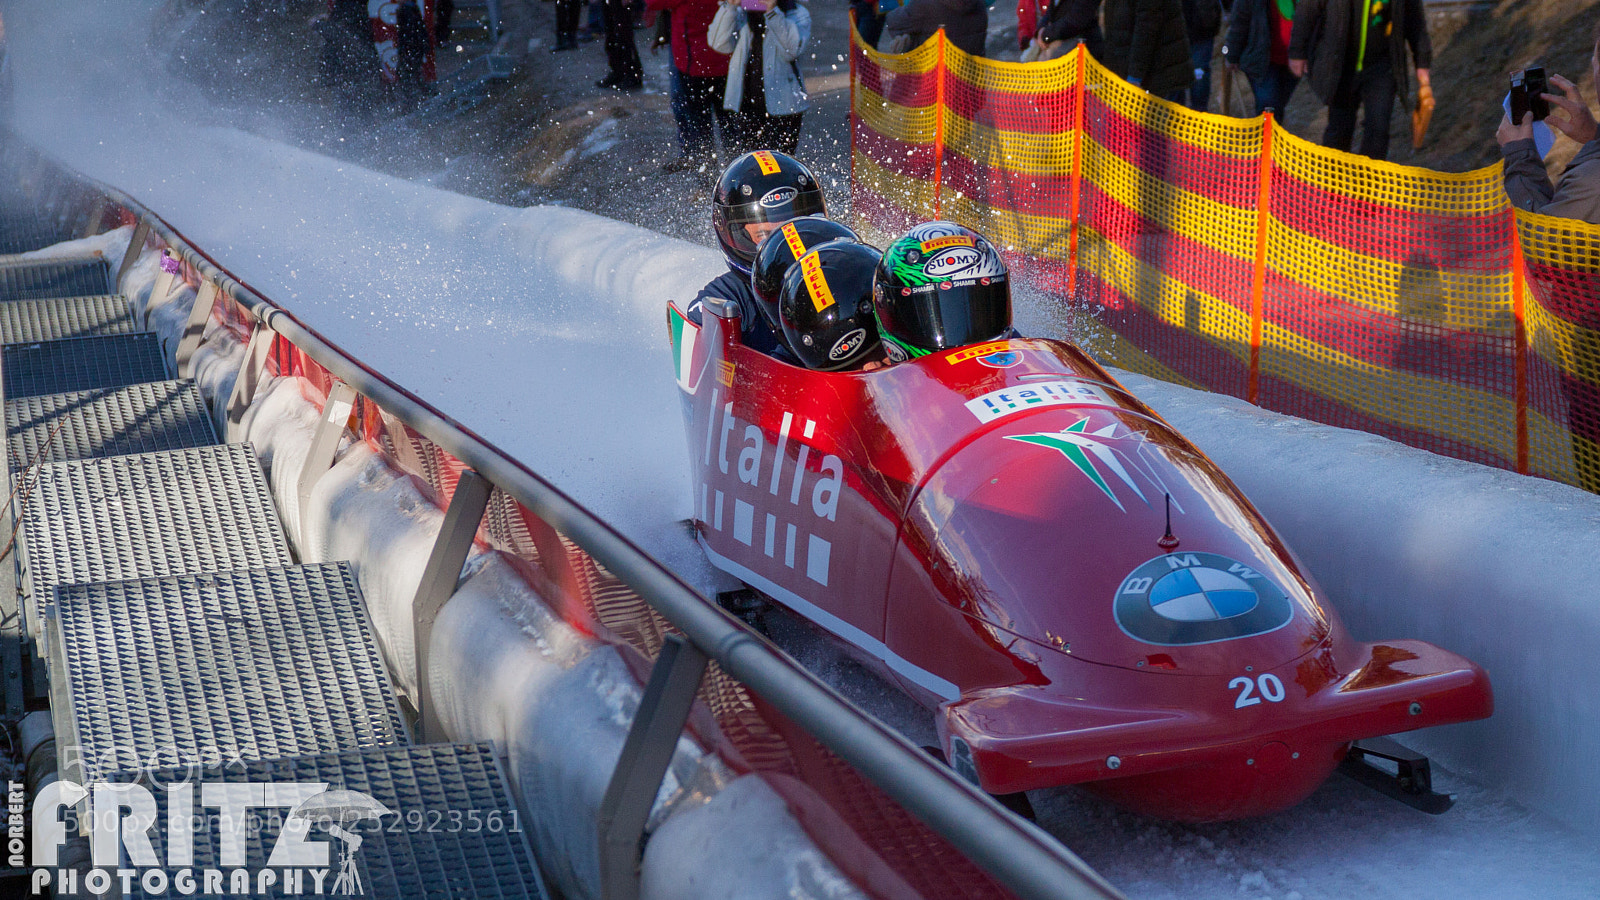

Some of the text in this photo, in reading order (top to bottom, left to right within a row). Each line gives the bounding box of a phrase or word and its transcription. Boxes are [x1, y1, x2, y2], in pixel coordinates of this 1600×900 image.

[782, 223, 806, 258] PIRELL
[929, 255, 977, 270] SUOMY
[804, 255, 827, 306] PIRELLI
[953, 279, 976, 288] SHAMIR
[831, 333, 863, 358] SUOMY
[982, 385, 1096, 409] Italia
[704, 387, 844, 523] Italia
[1121, 553, 1264, 595] BMW
[1227, 673, 1286, 710] 20
